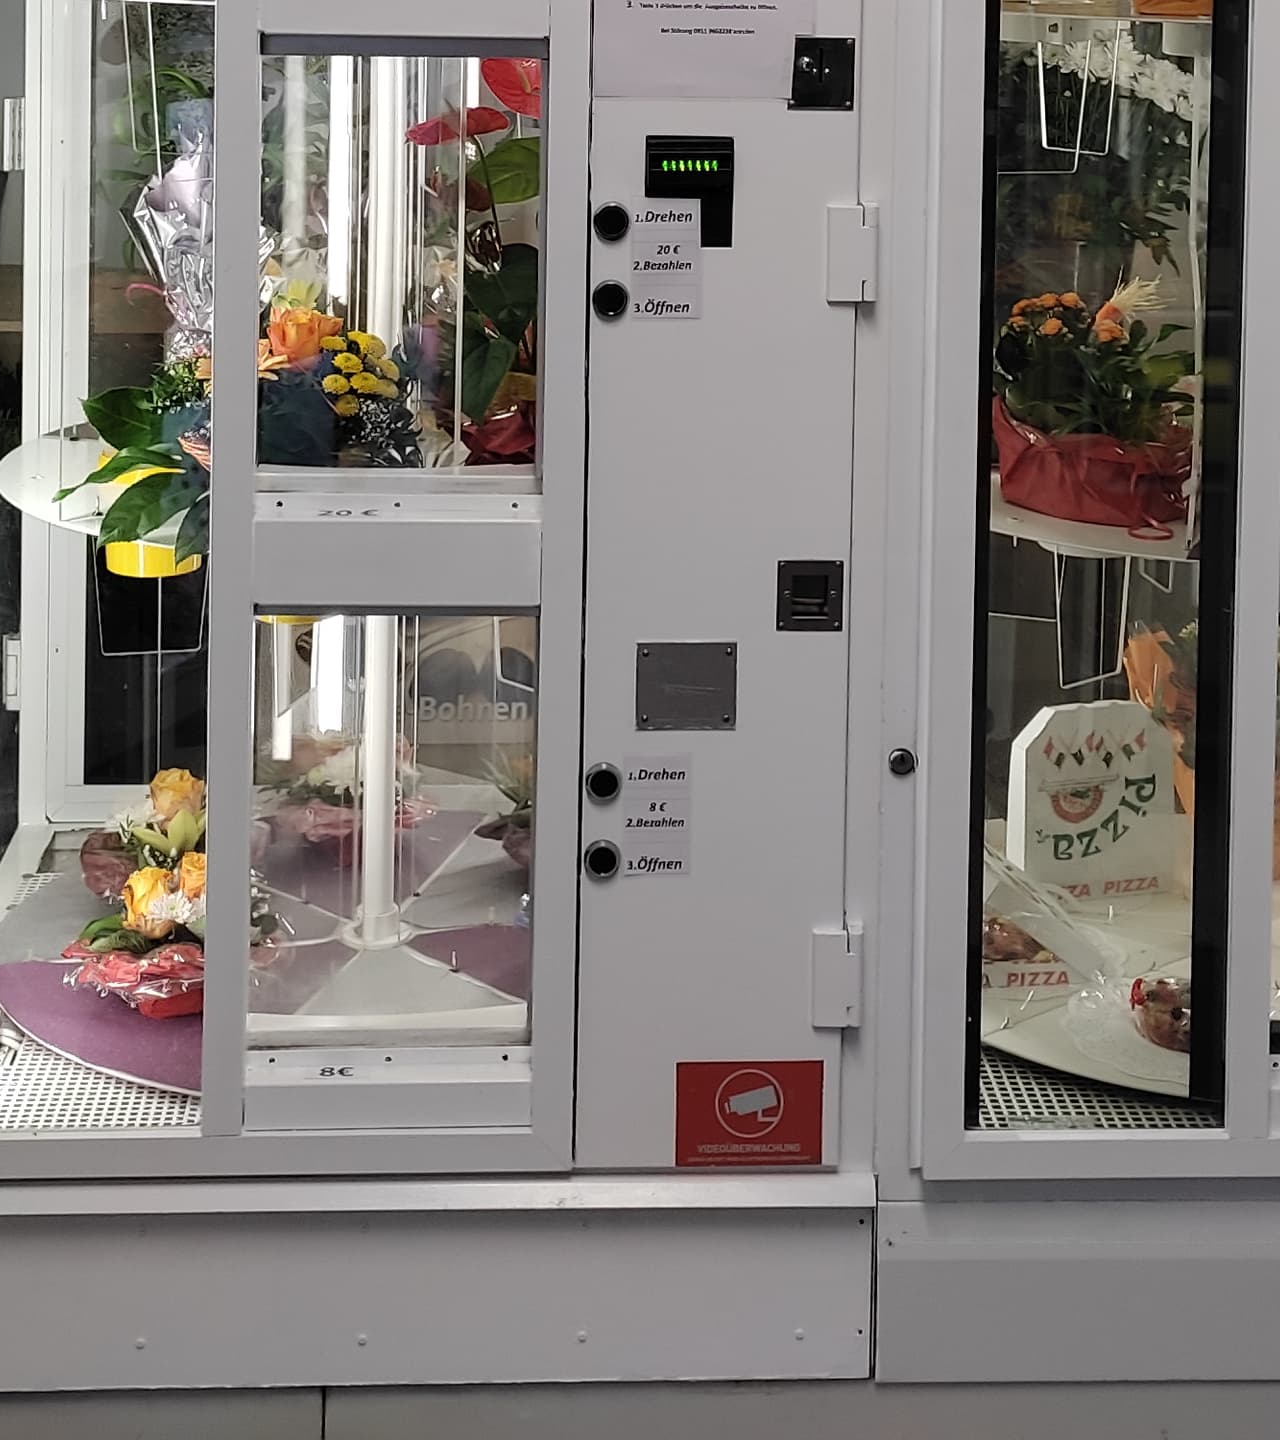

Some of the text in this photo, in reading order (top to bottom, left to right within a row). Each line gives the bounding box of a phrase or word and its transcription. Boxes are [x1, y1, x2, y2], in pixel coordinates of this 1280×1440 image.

[634, 210, 693, 224] 1.Drehen
[656, 245, 680, 255] 20 €
[633, 260, 692, 272] 2.Bezahlen
[633, 298, 690, 315] 3.Öffnen
[419, 693, 528, 721] Bohnen
[627, 767, 686, 782] 1.Drehen
[649, 801, 667, 812] 8 €
[625, 816, 685, 829] 2.Bezahlen
[627, 855, 683, 872] 3.Öffnen
[1104, 876, 1159, 895] PIZZA
[1007, 971, 1070, 987] PIZZA
[320, 1066, 354, 1077] 8€
